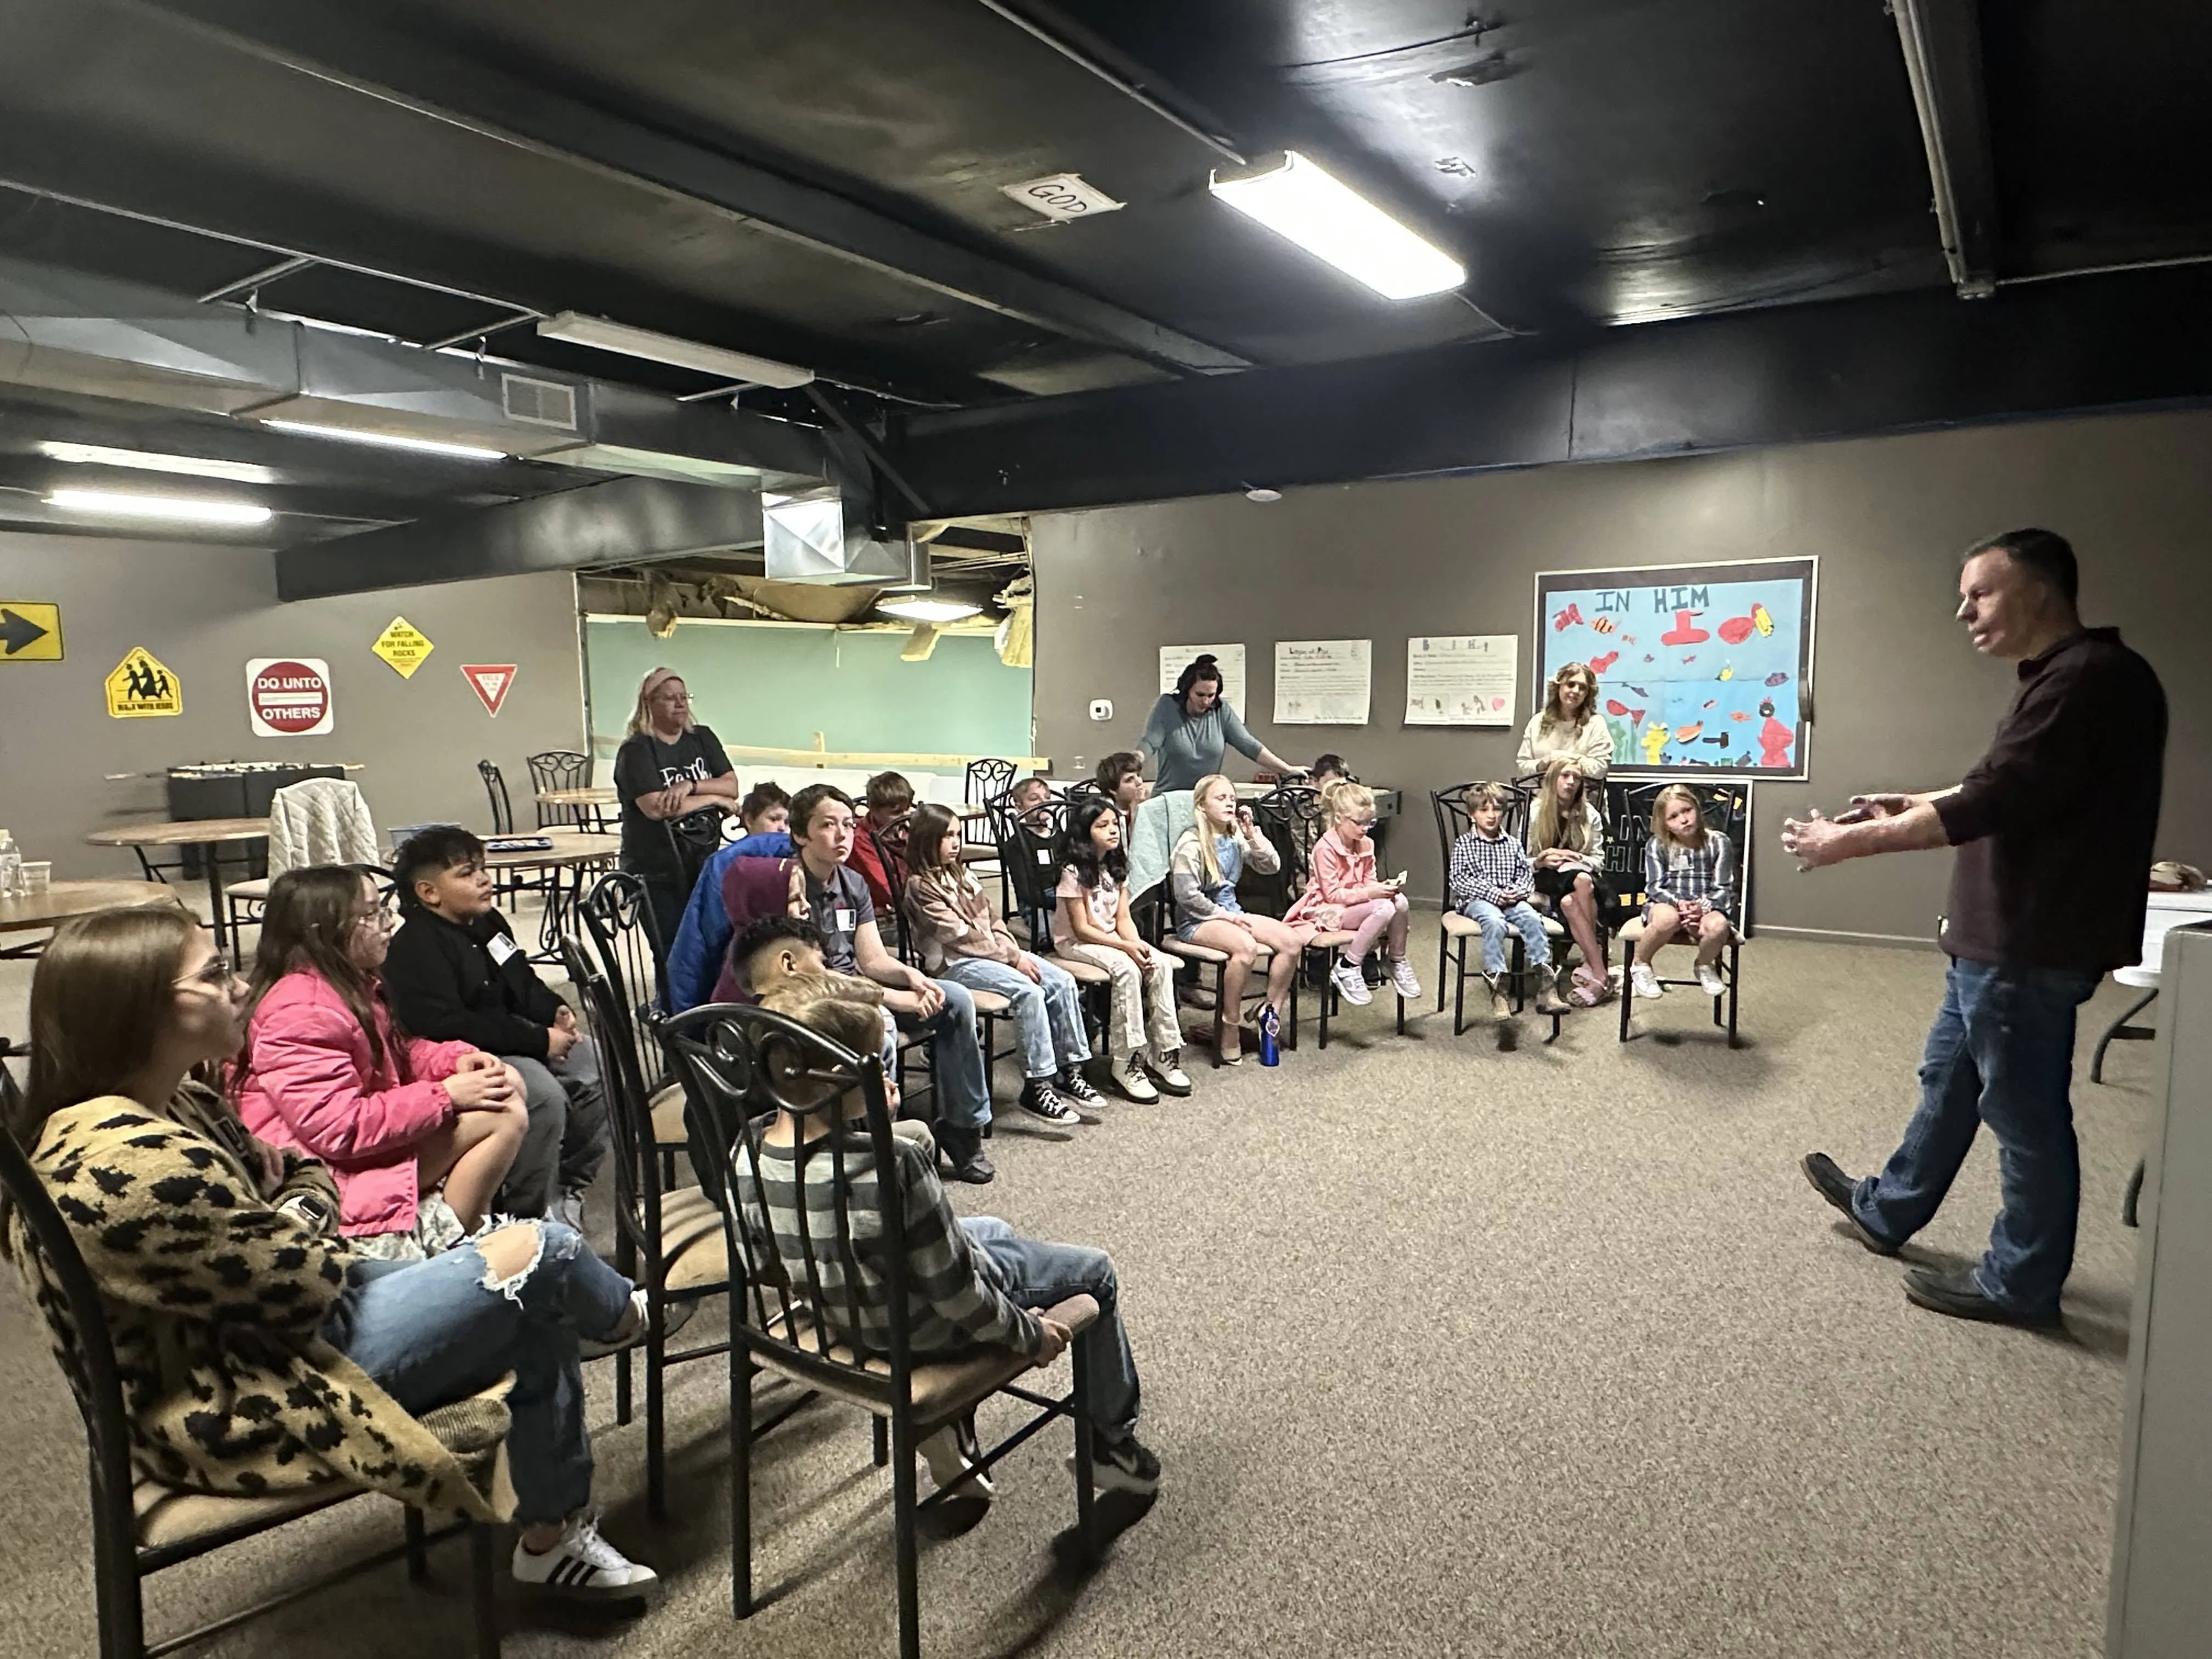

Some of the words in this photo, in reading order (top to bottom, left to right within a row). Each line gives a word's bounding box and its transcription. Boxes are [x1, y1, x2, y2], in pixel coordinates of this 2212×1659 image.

[1028, 184, 1087, 213] GOD
[1595, 590, 1630, 612] IN
[1654, 585, 1709, 613] HIM
[257, 677, 280, 690] DO
[282, 677, 322, 689] UNTO
[262, 707, 321, 720] OTHERS
